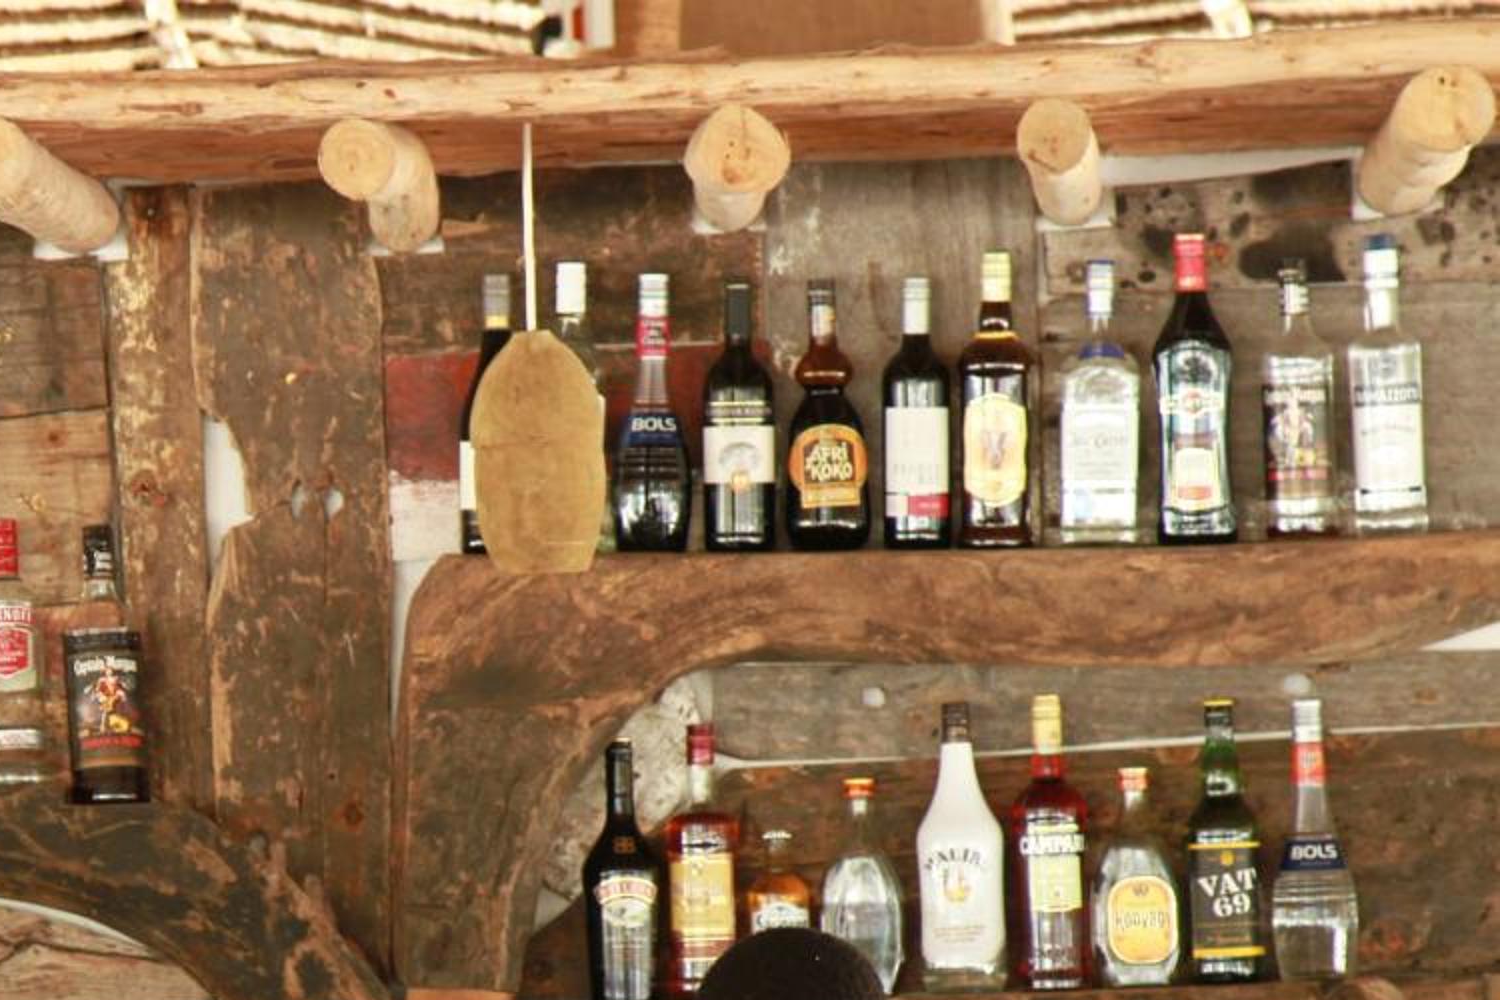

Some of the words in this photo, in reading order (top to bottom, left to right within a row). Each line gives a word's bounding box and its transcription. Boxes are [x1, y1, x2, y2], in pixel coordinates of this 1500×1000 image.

[631, 417, 677, 432] BOLS
[809, 461, 853, 482] KOKO
[1290, 844, 1337, 861] BOLS
[1199, 867, 1257, 899] VAT
[1212, 892, 1252, 918] 69
